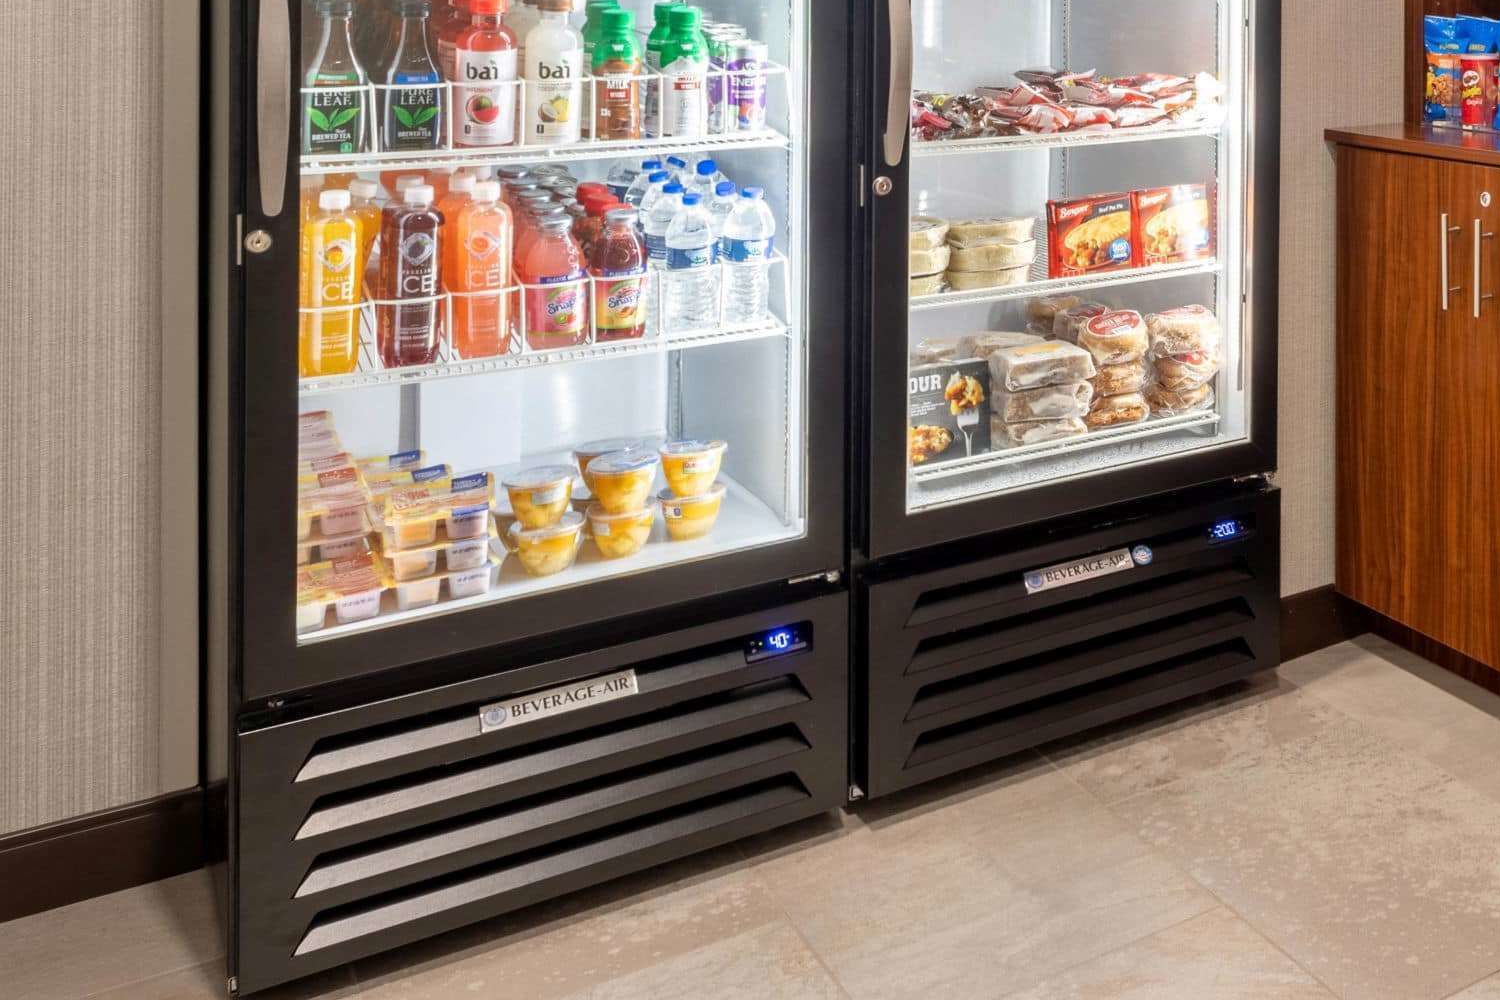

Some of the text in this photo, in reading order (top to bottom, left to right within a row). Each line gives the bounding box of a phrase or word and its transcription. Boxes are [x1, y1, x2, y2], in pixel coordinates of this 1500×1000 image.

[466, 60, 499, 81] bai
[538, 59, 571, 80] bai
[511, 677, 629, 718] BEVERAGE-AIR
